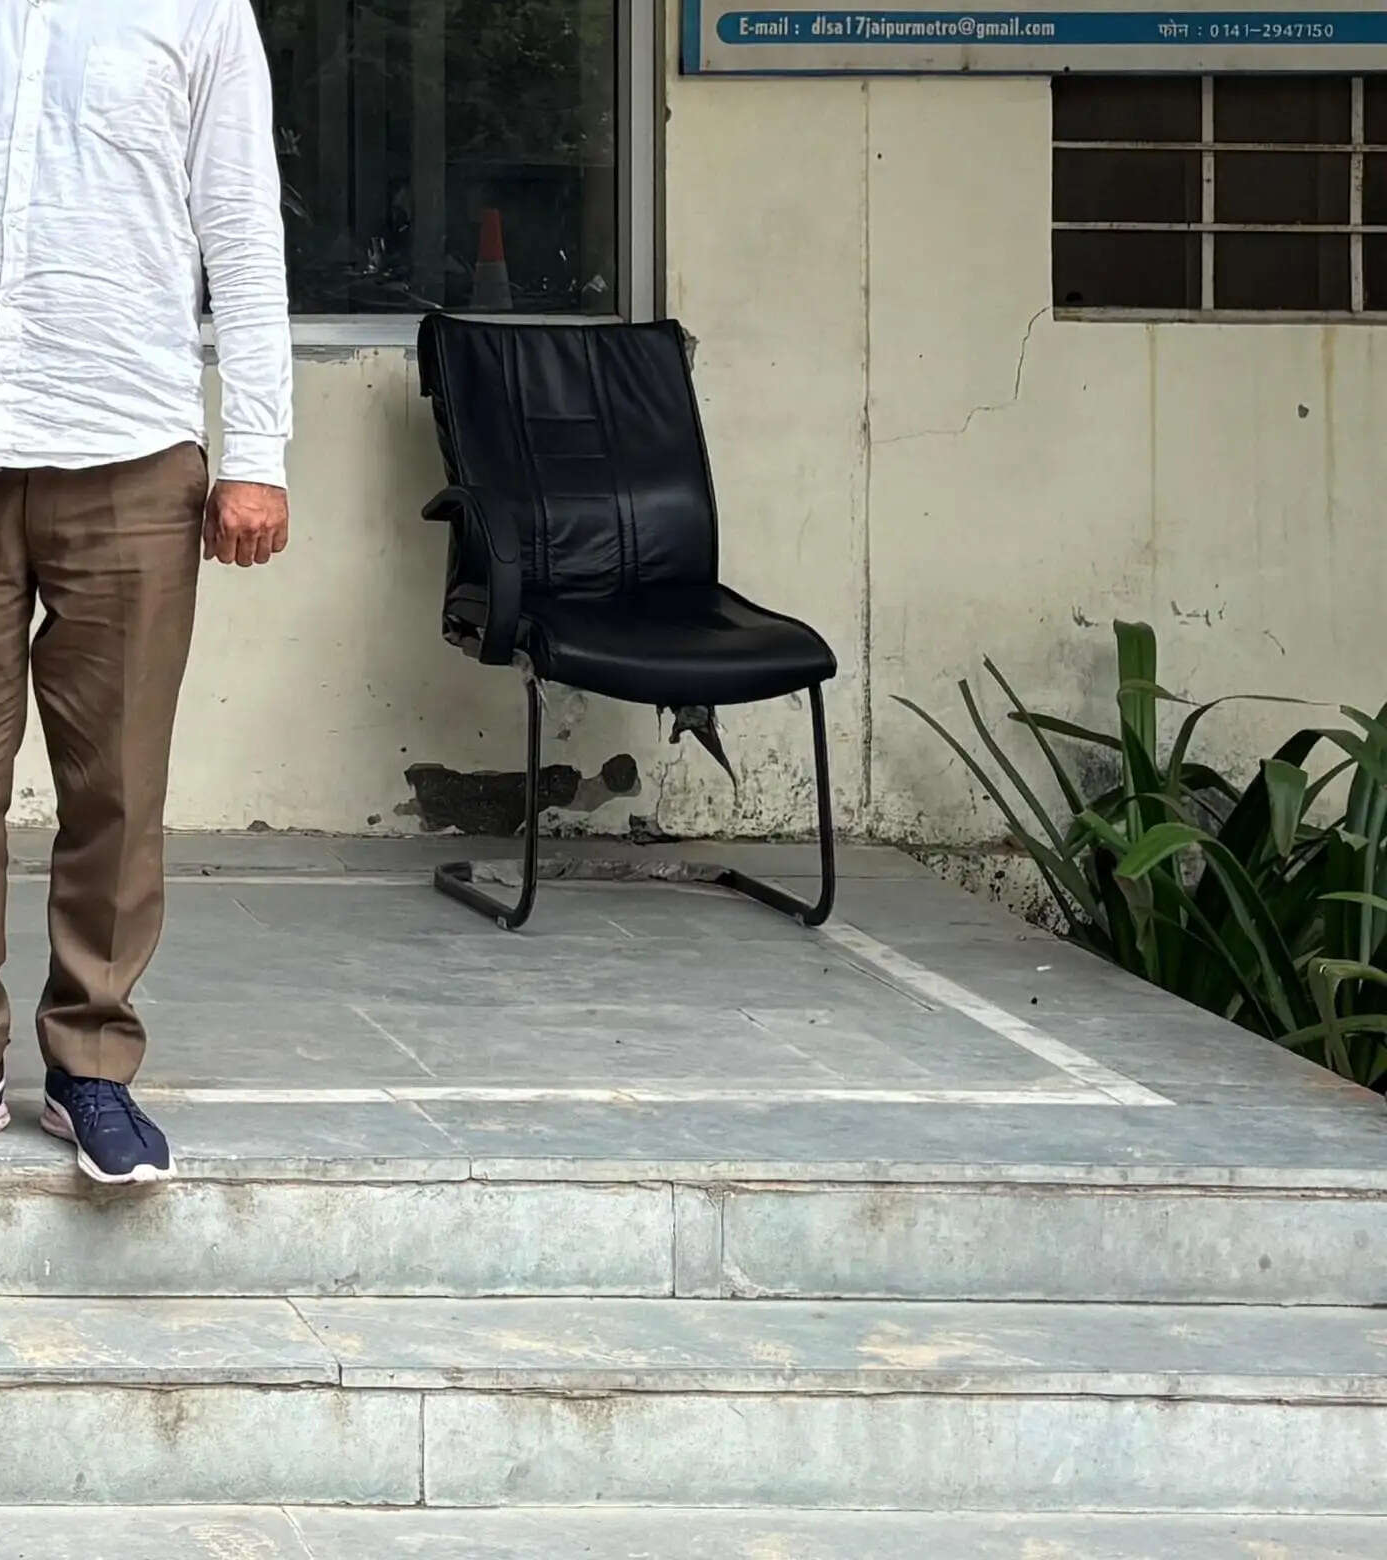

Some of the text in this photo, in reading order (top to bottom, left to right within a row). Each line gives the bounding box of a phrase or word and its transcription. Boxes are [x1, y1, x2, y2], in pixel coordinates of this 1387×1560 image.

[739, 17, 788, 35] E-mail
[1159, 19, 1188, 37] फोन
[1210, 23, 1334, 38] 0141-2947150
